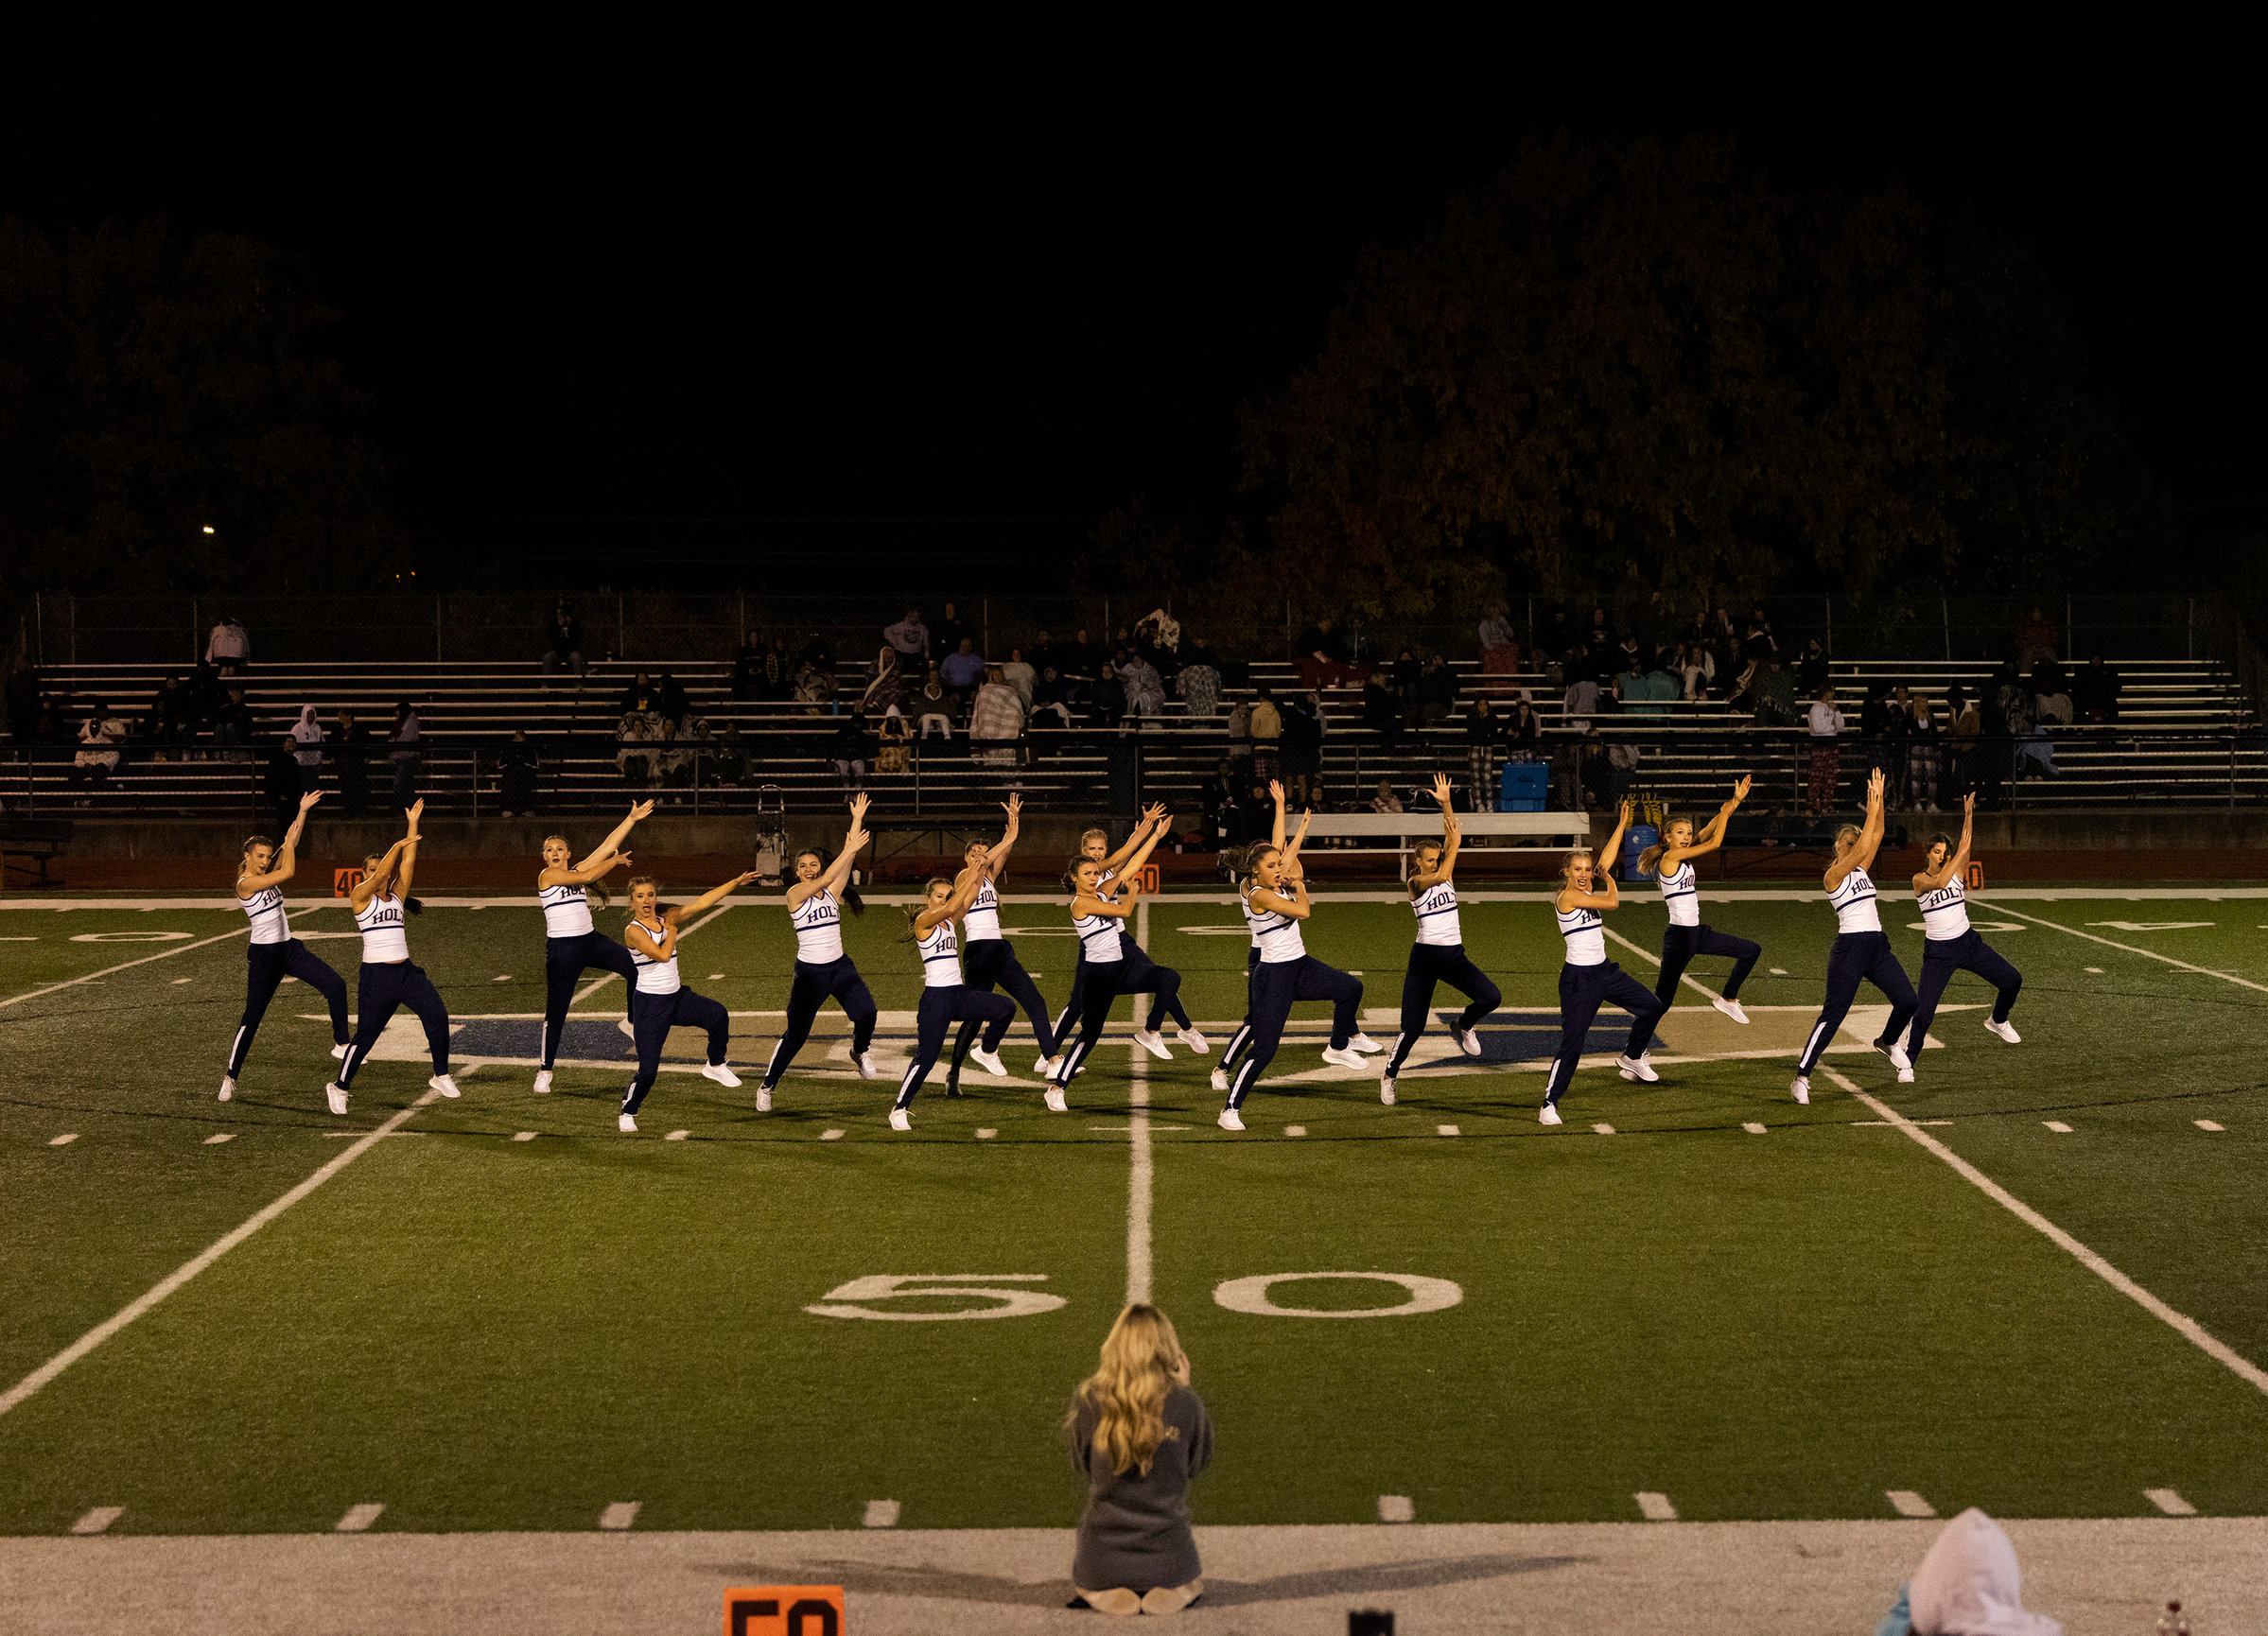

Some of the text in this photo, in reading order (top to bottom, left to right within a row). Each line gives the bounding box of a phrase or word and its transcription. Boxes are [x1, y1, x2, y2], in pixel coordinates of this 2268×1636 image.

[262, 885, 282, 907] HOL
[560, 884, 585, 899] HOL
[975, 890, 998, 906] HOL
[372, 908, 404, 925] HOL
[934, 936, 957, 954] HOL
